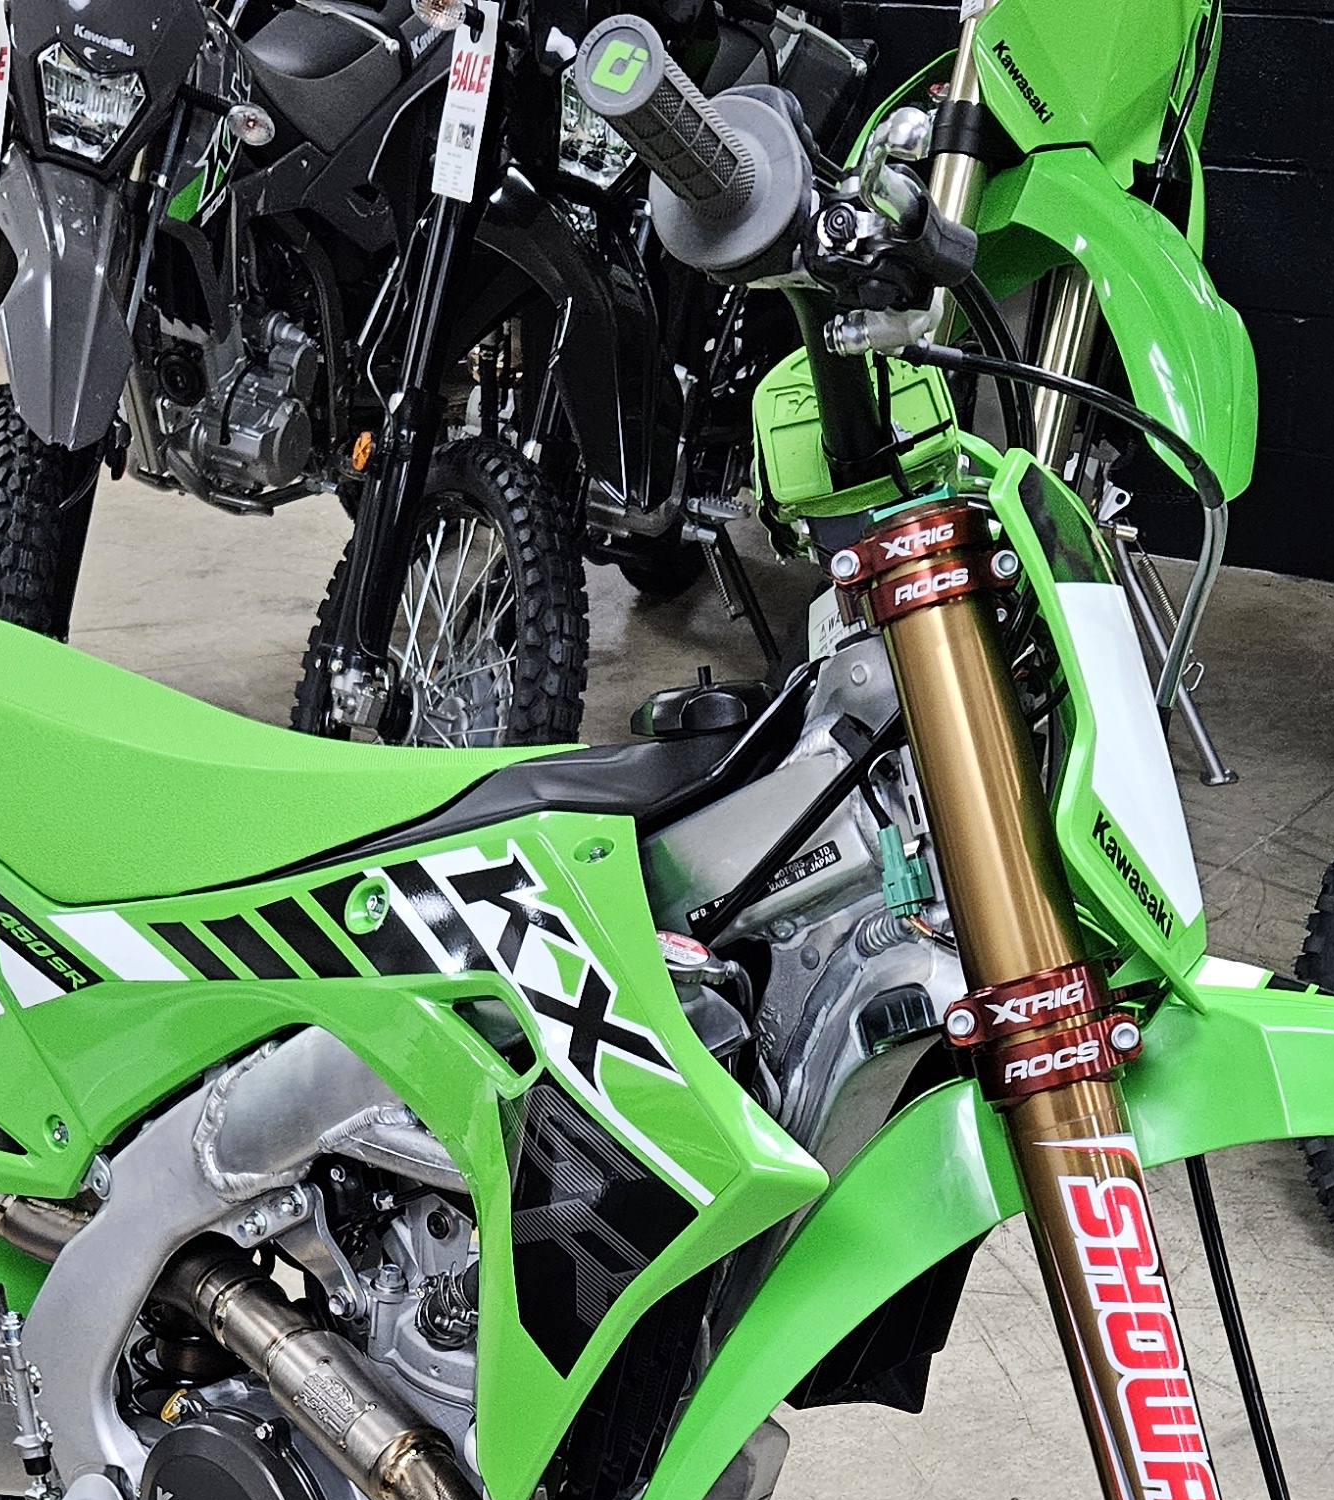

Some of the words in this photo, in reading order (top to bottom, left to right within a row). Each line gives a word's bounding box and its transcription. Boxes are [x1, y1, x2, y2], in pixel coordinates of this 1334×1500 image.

[451, 50, 491, 93] SALE
[992, 39, 1054, 124] Kawasaki
[879, 522, 954, 560] XTRIG
[895, 567, 969, 606] ROCS
[768, 877, 791, 892] MADE
[794, 869, 806, 880] IN
[810, 852, 836, 872] JAPAN
[1092, 810, 1174, 940] Kawasaki
[446, 853, 679, 1096] KX
[984, 980, 1085, 1026] XTRIG
[1004, 1039, 1100, 1084] ROCS
